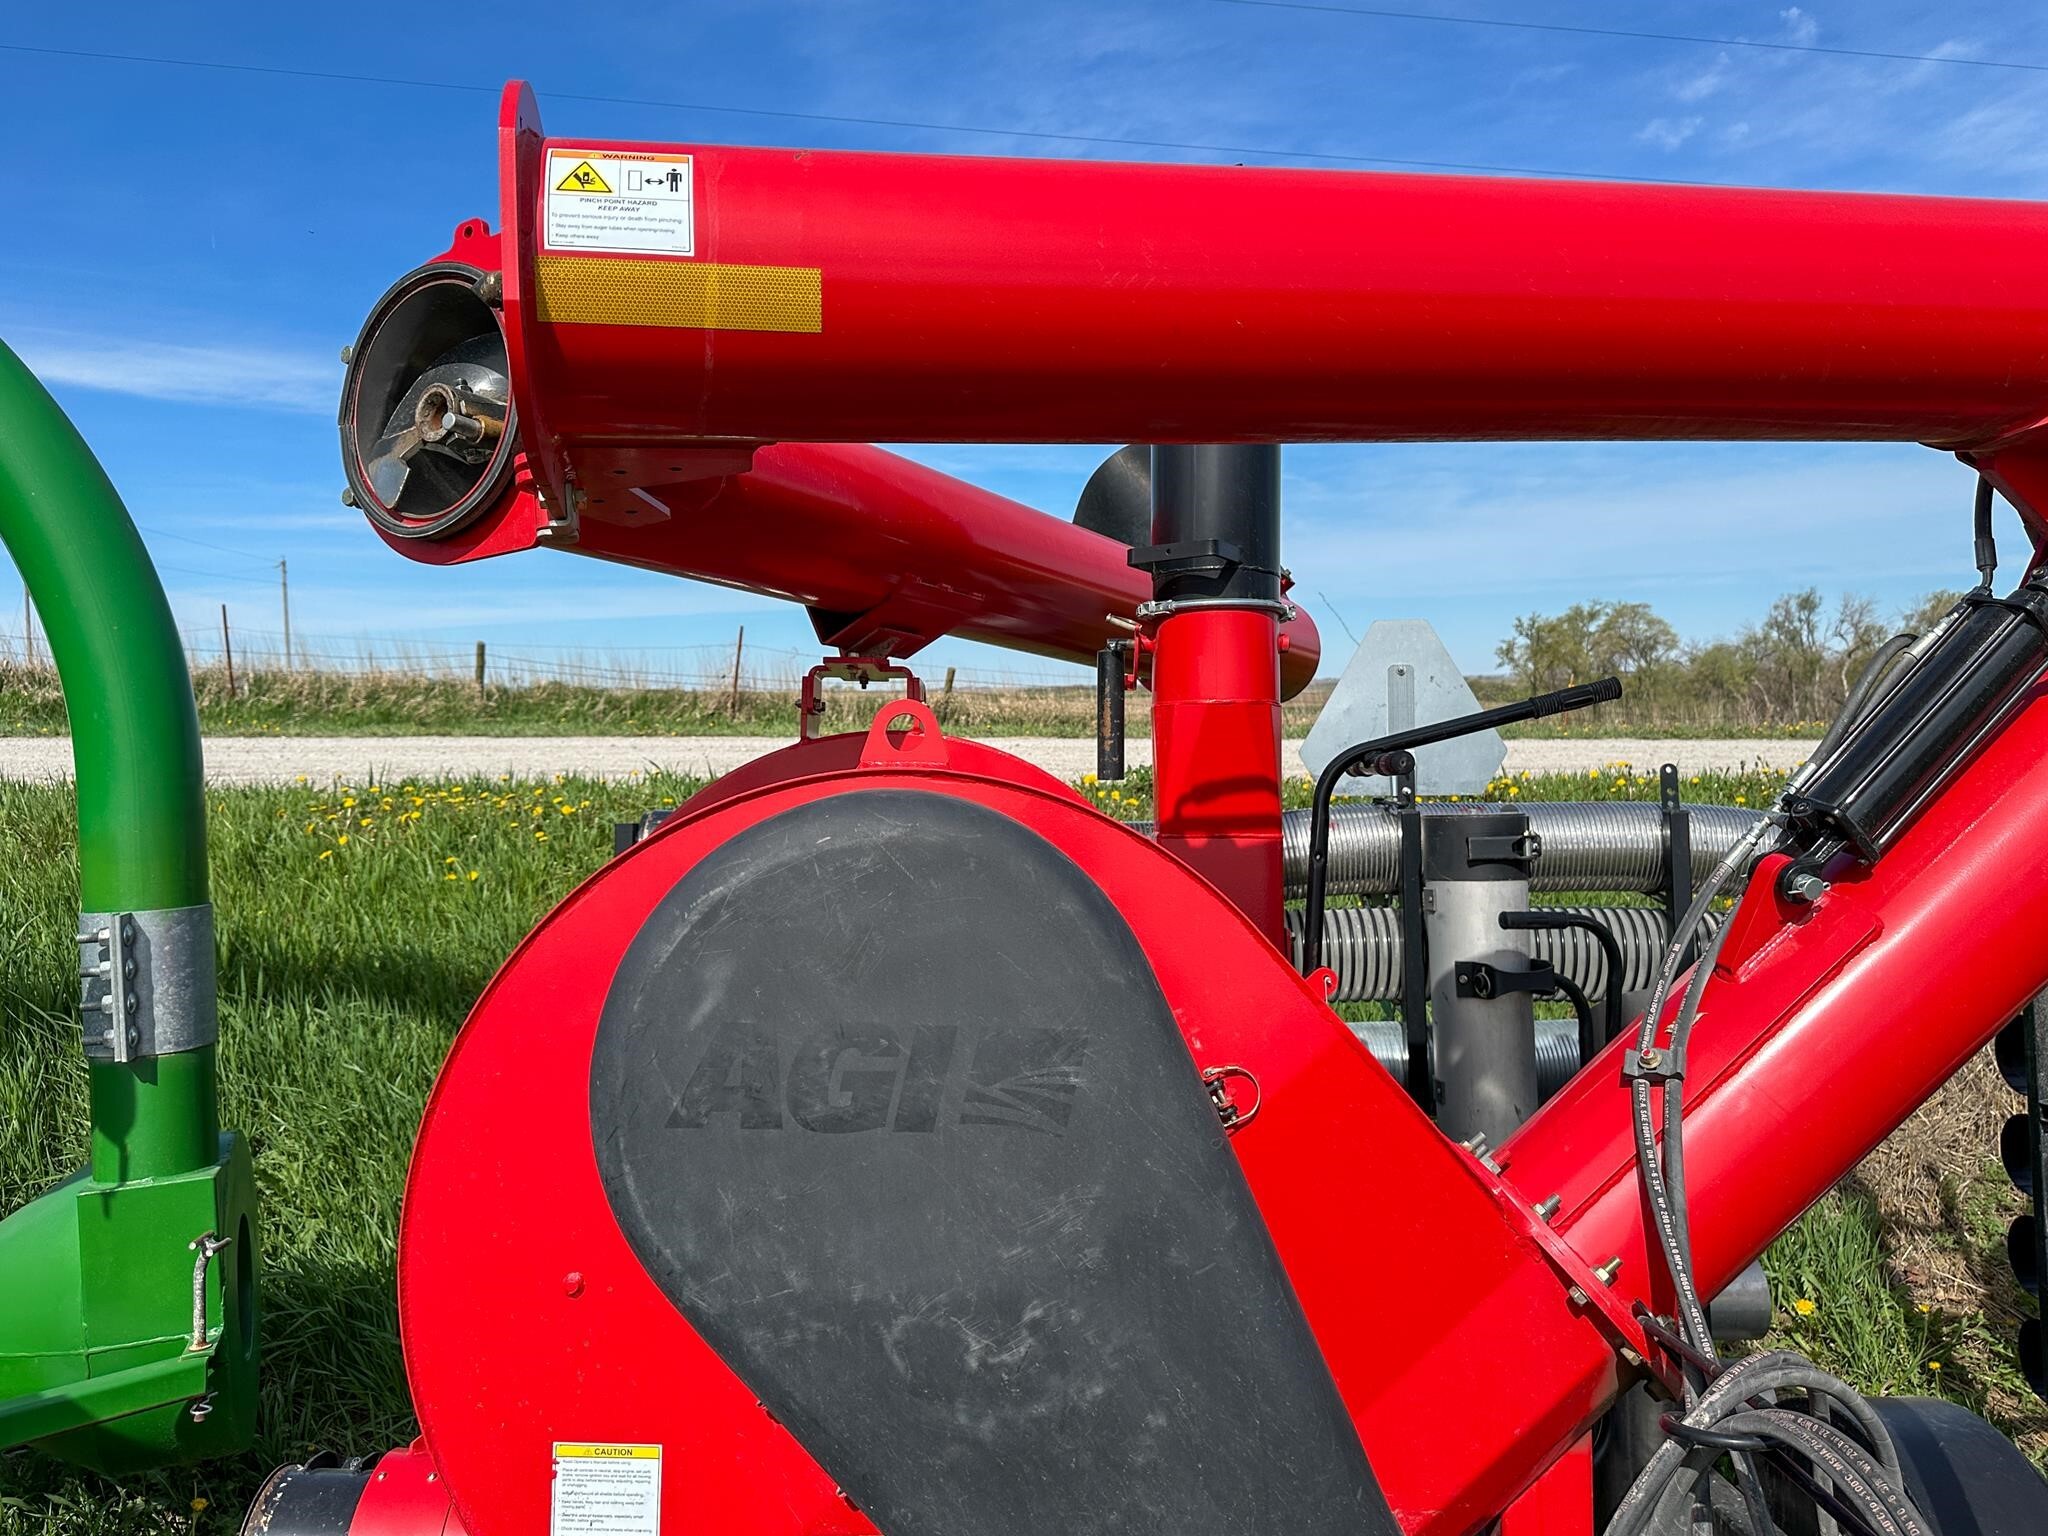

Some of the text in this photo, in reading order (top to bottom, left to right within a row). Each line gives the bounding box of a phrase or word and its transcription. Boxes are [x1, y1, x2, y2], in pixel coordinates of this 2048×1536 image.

[602, 153, 656, 161] WARNING
[664, 1021, 959, 1135] AGI
[1638, 1083, 1647, 1108] 18752-A
[1640, 1110, 1649, 1124] SAE
[1646, 1149, 1655, 1159] DN
[1648, 1160, 1657, 1168] 10
[1656, 1197, 1667, 1209] WP
[1664, 1223, 1673, 1236] bar
[1673, 1253, 1684, 1270] MPa
[1696, 1322, 1704, 1332] to
[594, 1448, 633, 1456] CAUTION
[1904, 1521, 1921, 1536] DN
